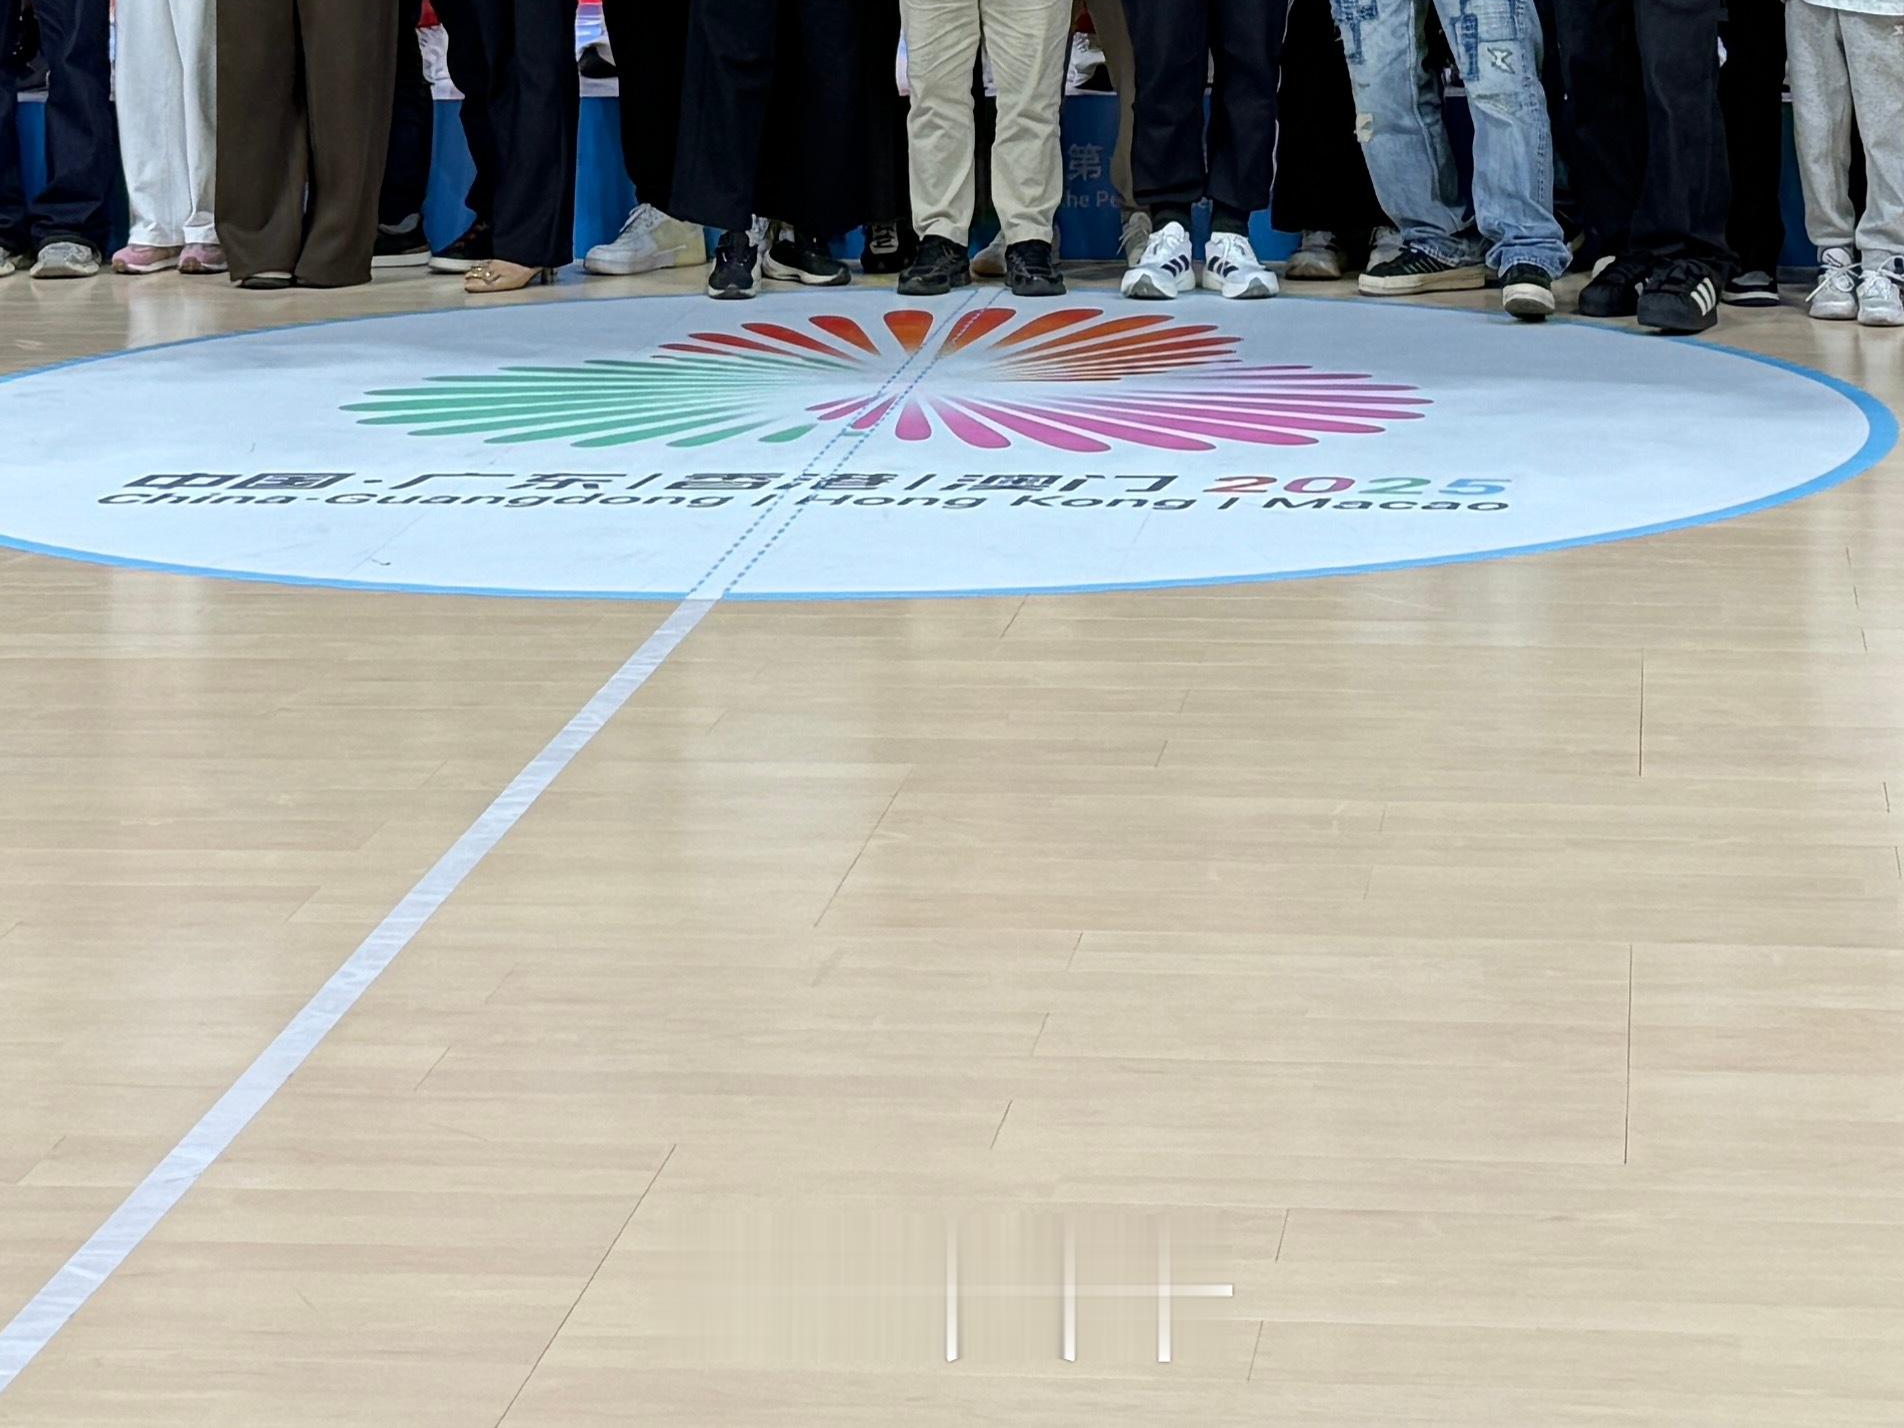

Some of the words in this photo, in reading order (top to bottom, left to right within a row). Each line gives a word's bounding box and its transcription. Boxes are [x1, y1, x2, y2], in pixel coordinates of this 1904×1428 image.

[1201, 475, 1513, 495] 2025
[794, 494, 988, 509] Hong
[1009, 494, 1198, 511] Kong
[1262, 496, 1510, 512] Macao
